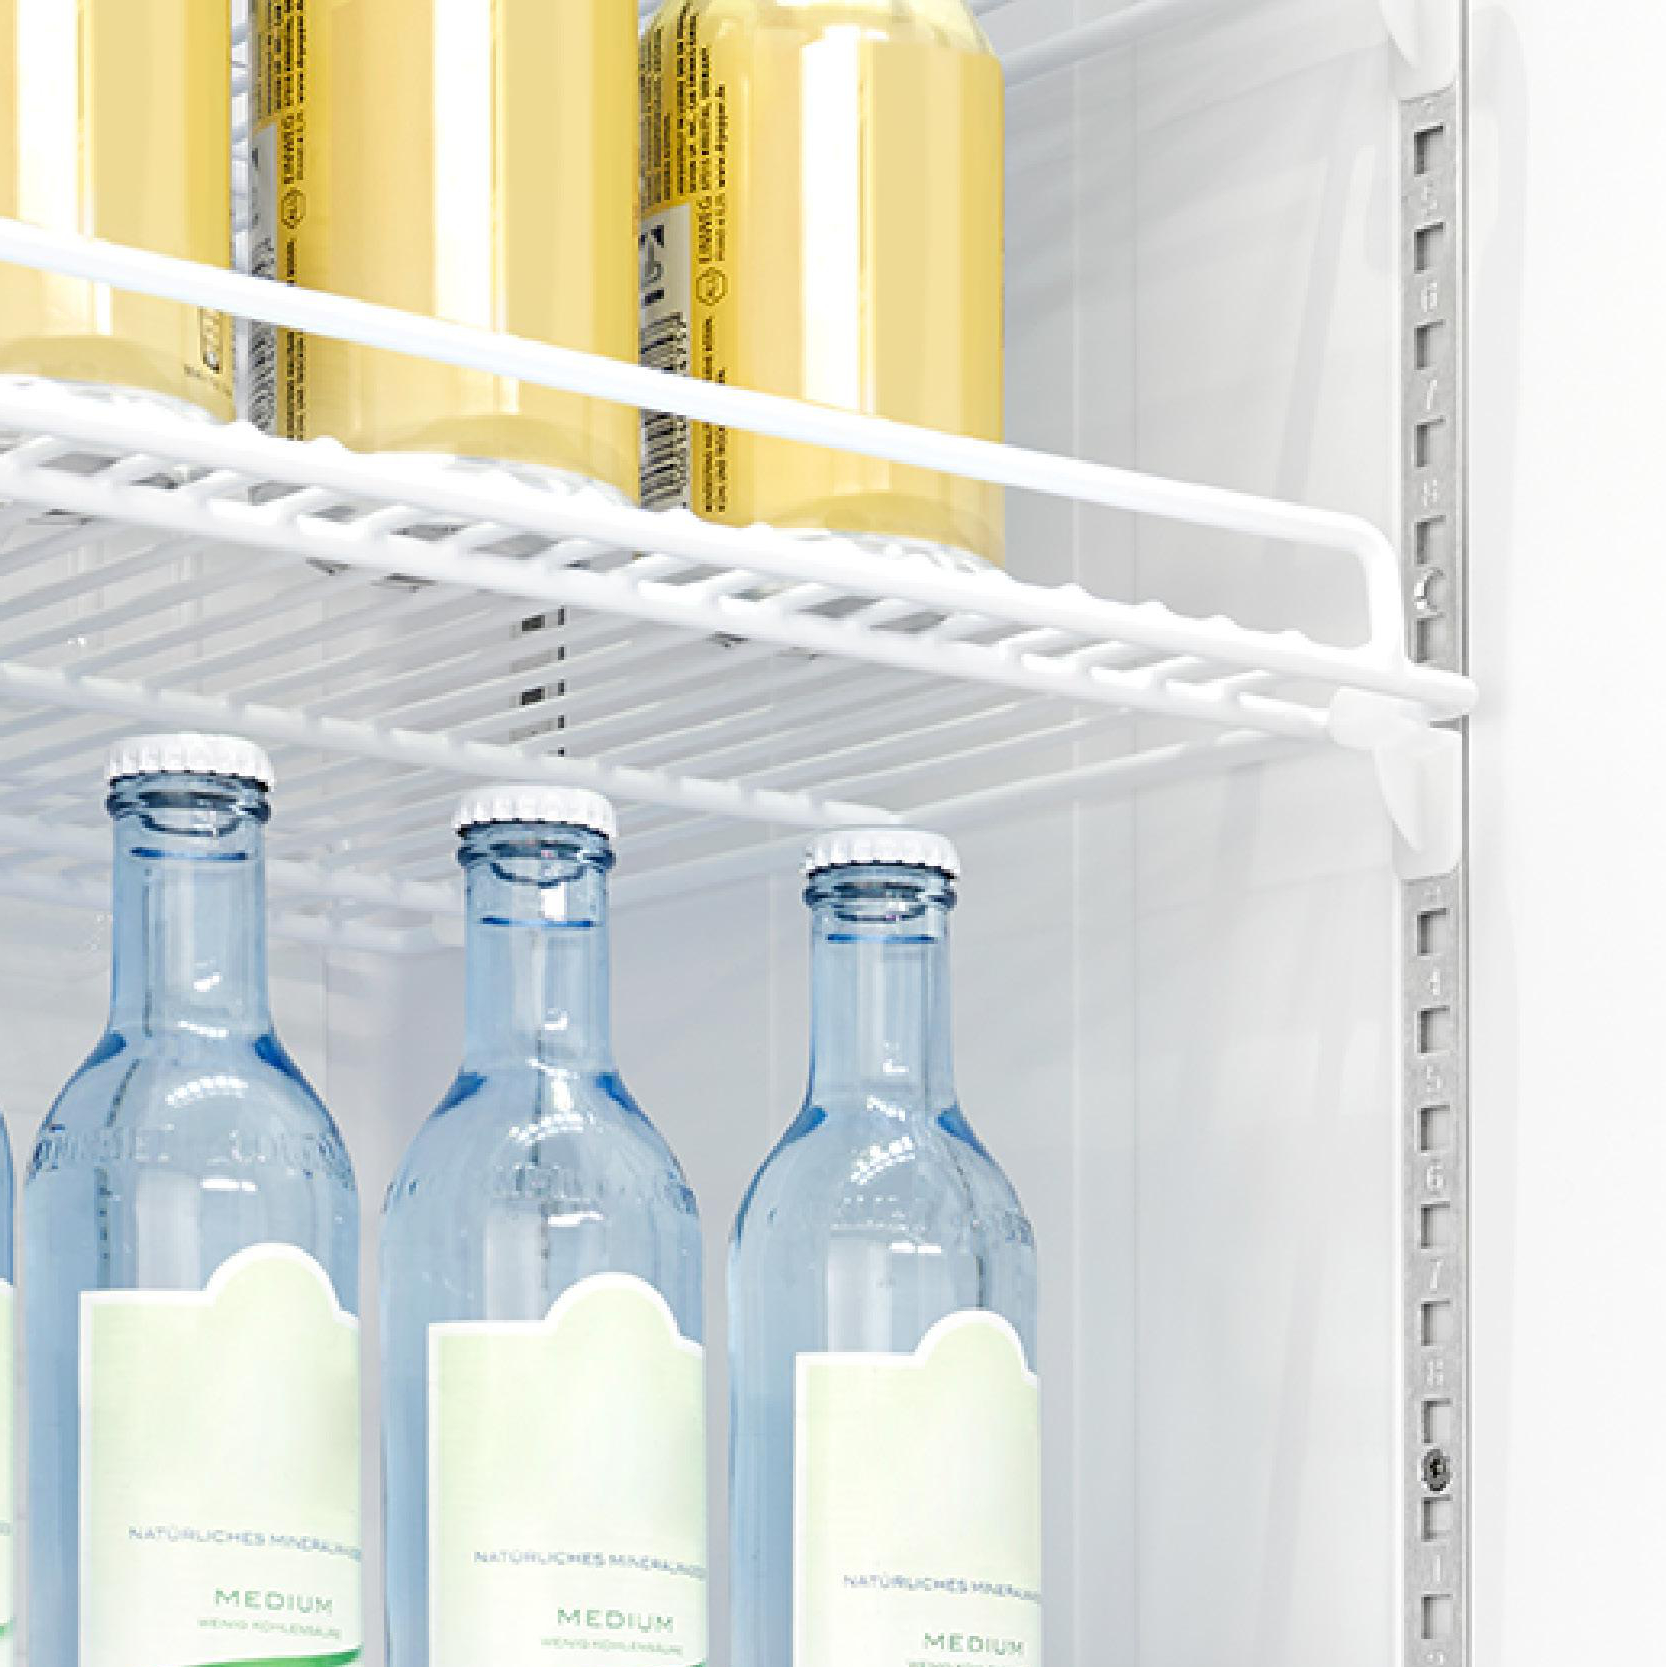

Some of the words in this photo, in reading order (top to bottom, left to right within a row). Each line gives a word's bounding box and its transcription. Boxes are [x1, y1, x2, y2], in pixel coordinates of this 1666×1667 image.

[698, 196, 712, 264] EINWEG
[129, 1524, 265, 1546] NATÜRLICHES
[214, 1588, 333, 1616] MEDIUM
[557, 1608, 674, 1634] MEDIUM
[924, 1632, 1025, 1656] MEDIUM
